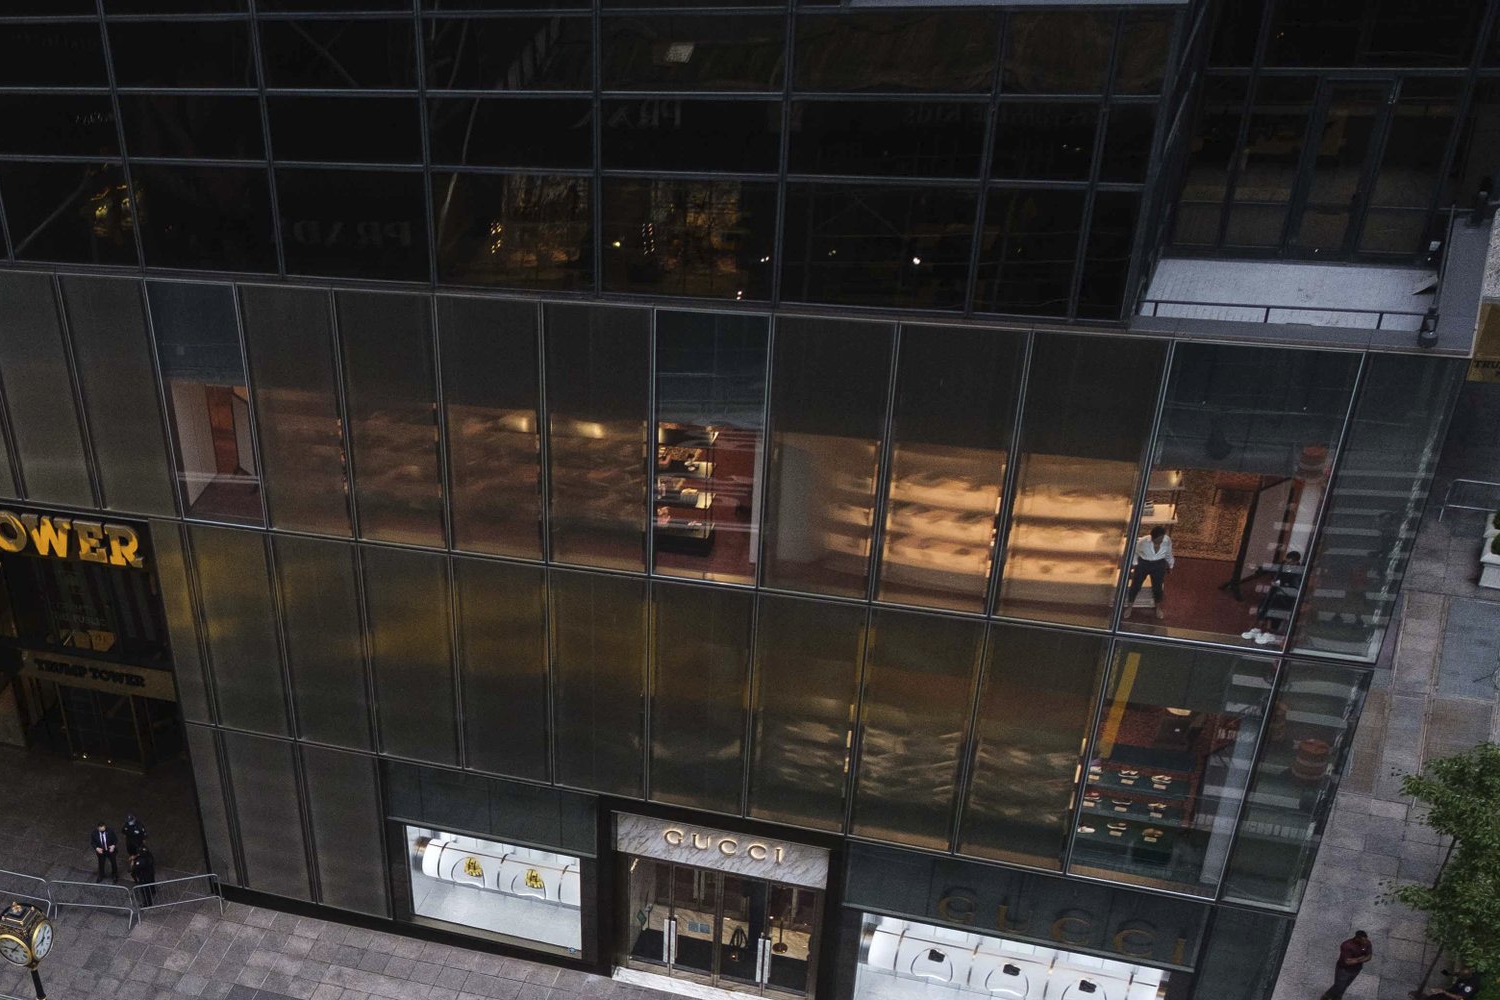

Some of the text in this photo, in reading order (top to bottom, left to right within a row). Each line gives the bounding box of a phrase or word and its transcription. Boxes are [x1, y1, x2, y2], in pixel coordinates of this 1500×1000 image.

[89, 667, 145, 687] TOWER
[664, 829, 783, 864] GUCCI
[938, 892, 1187, 966] GUCCI
